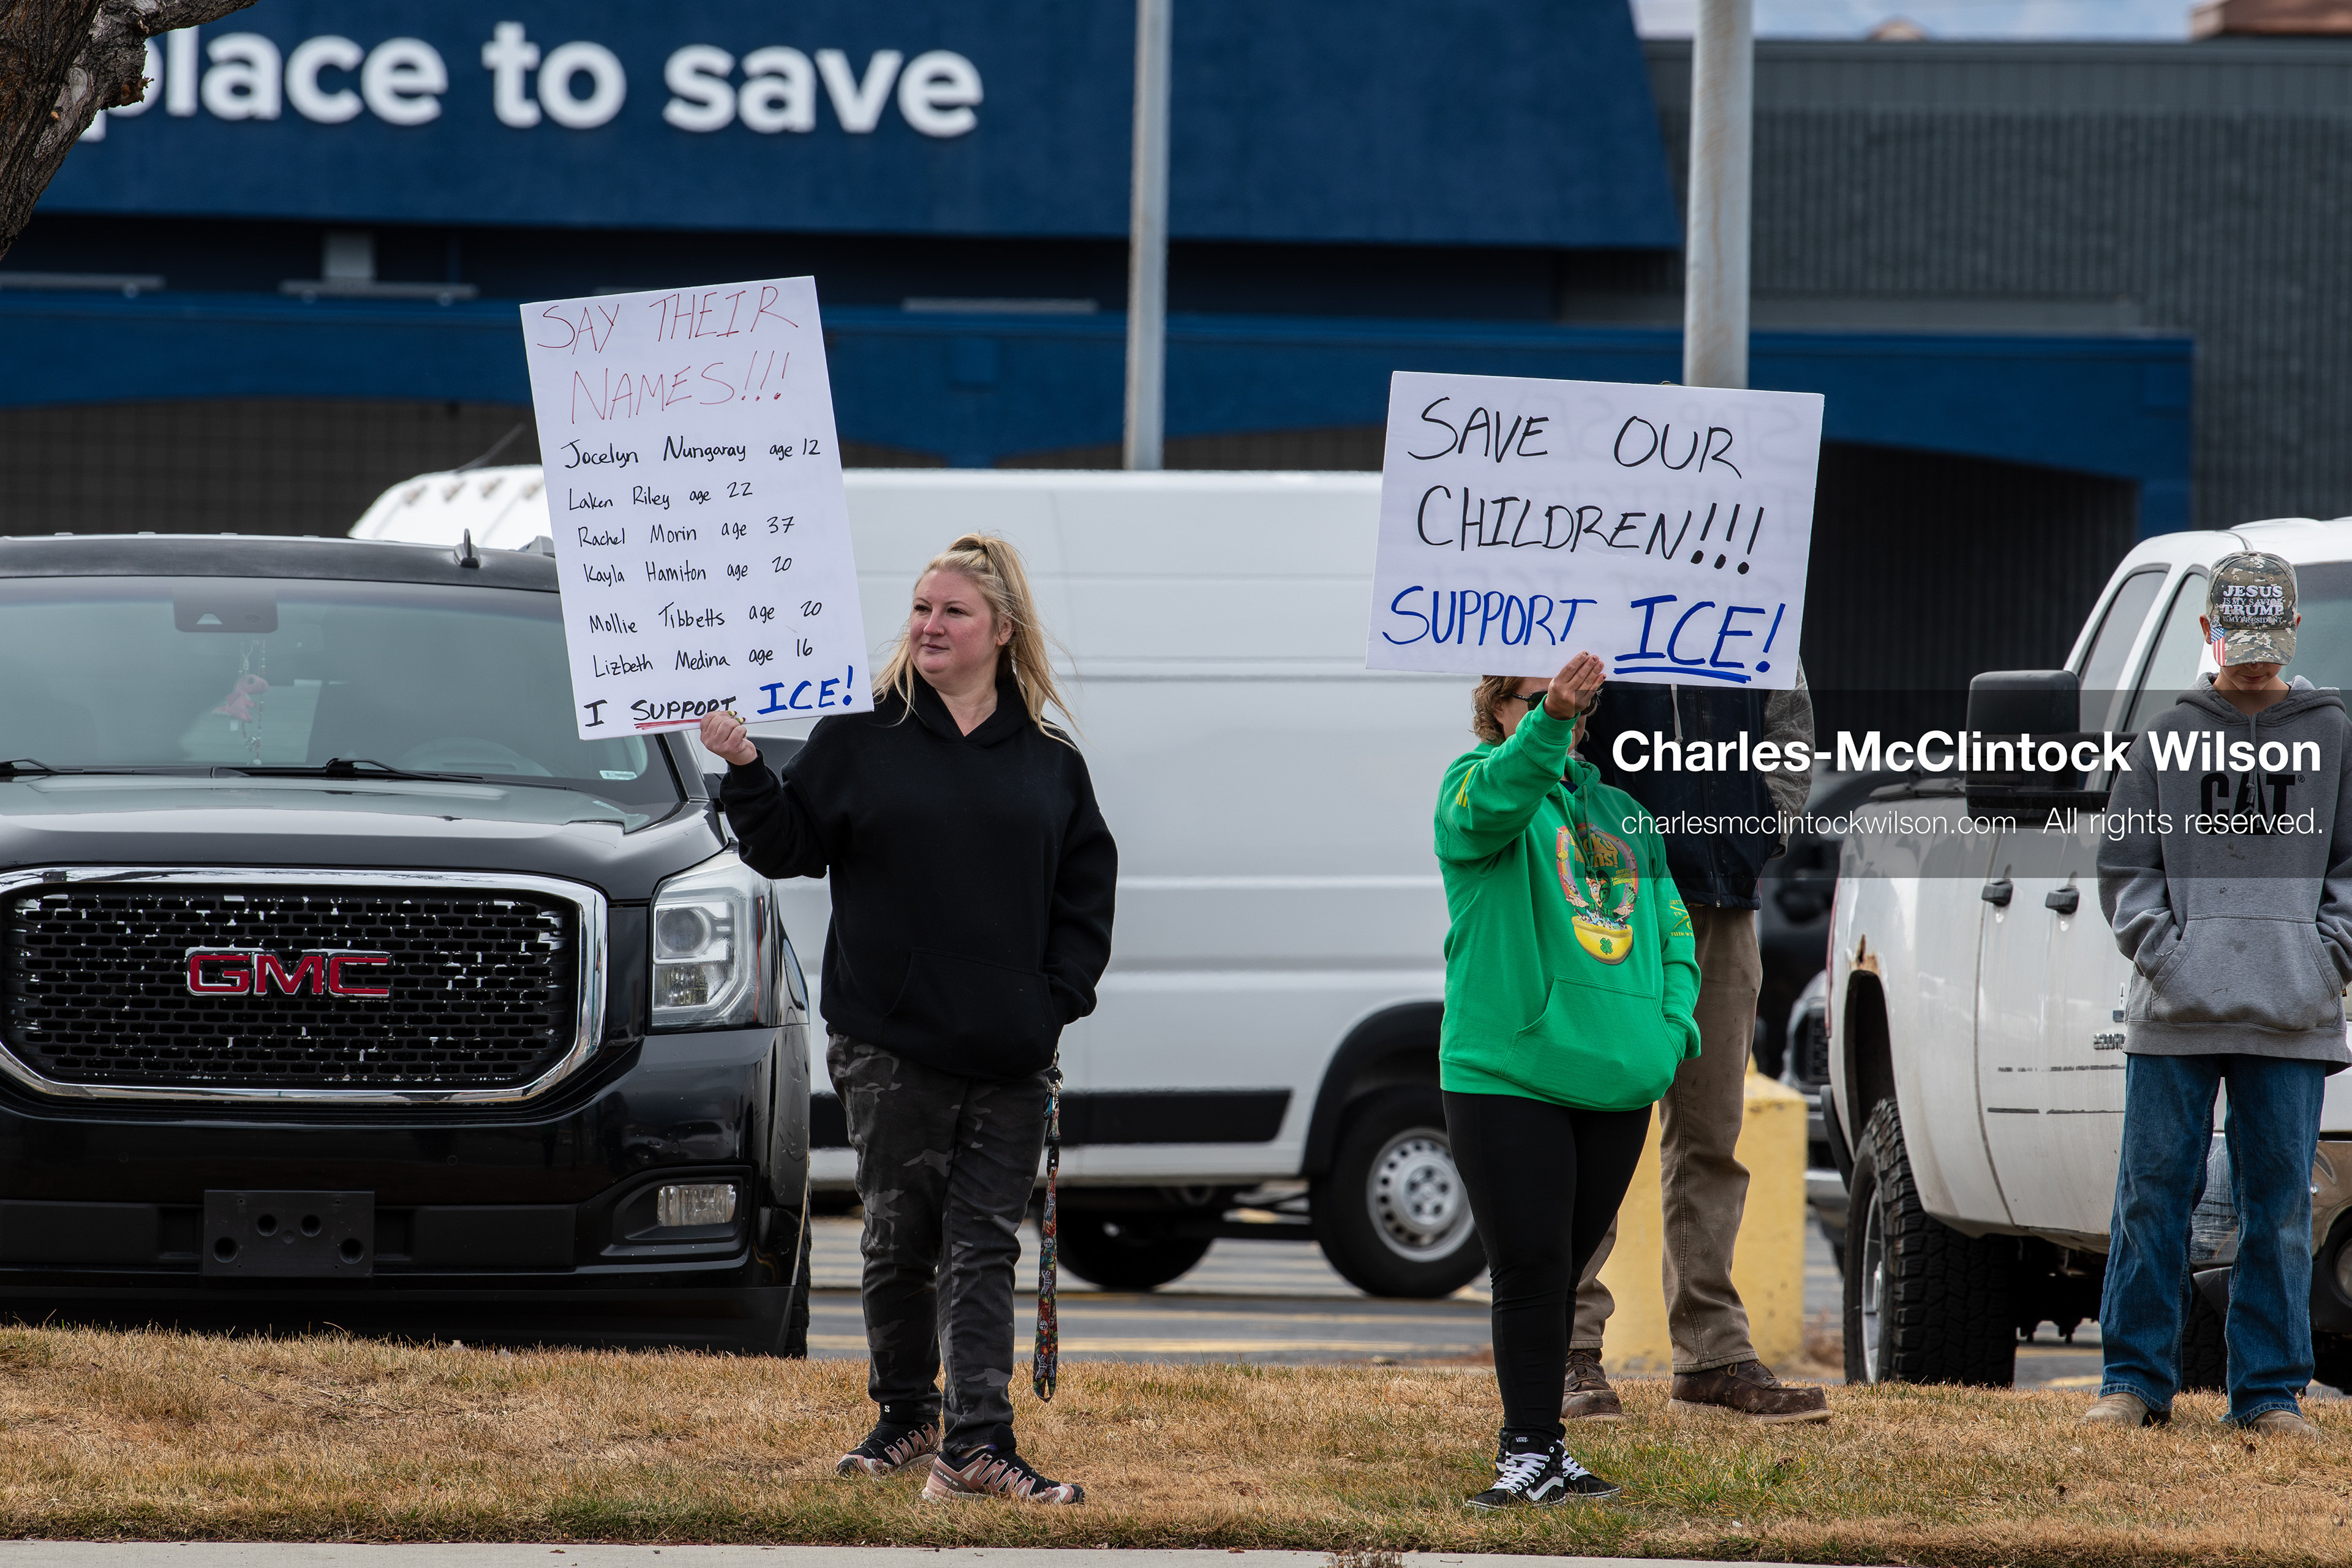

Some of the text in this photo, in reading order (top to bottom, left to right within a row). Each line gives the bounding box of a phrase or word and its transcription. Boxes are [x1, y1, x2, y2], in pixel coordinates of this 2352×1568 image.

[483, 22, 625, 127] to
[665, 45, 983, 136] save
[537, 286, 799, 355] SAY THEIR
[572, 350, 790, 424] NAMES!!!
[560, 435, 821, 469] Jocelyn Nungaray age 12
[1408, 396, 1550, 463] SAVE
[1613, 415, 1742, 479] OUR
[569, 481, 753, 511] Laken Riley age 22
[578, 516, 795, 548] Rachel Morin age 37
[1417, 485, 1765, 575] CHILDREN!!!
[583, 556, 793, 587] Kayla Hamiton age 20
[2223, 585, 2283, 597] JESUS
[589, 600, 823, 634] Mollie Tibbetts age 20
[1382, 586, 1786, 673] SUPPORT ICE!
[2222, 605, 2284, 616] TRUMP
[593, 638, 813, 677] Lizbeth Medina age 16
[584, 665, 853, 728] I SUPPORT ICE!
[187, 951, 391, 996] GMC
